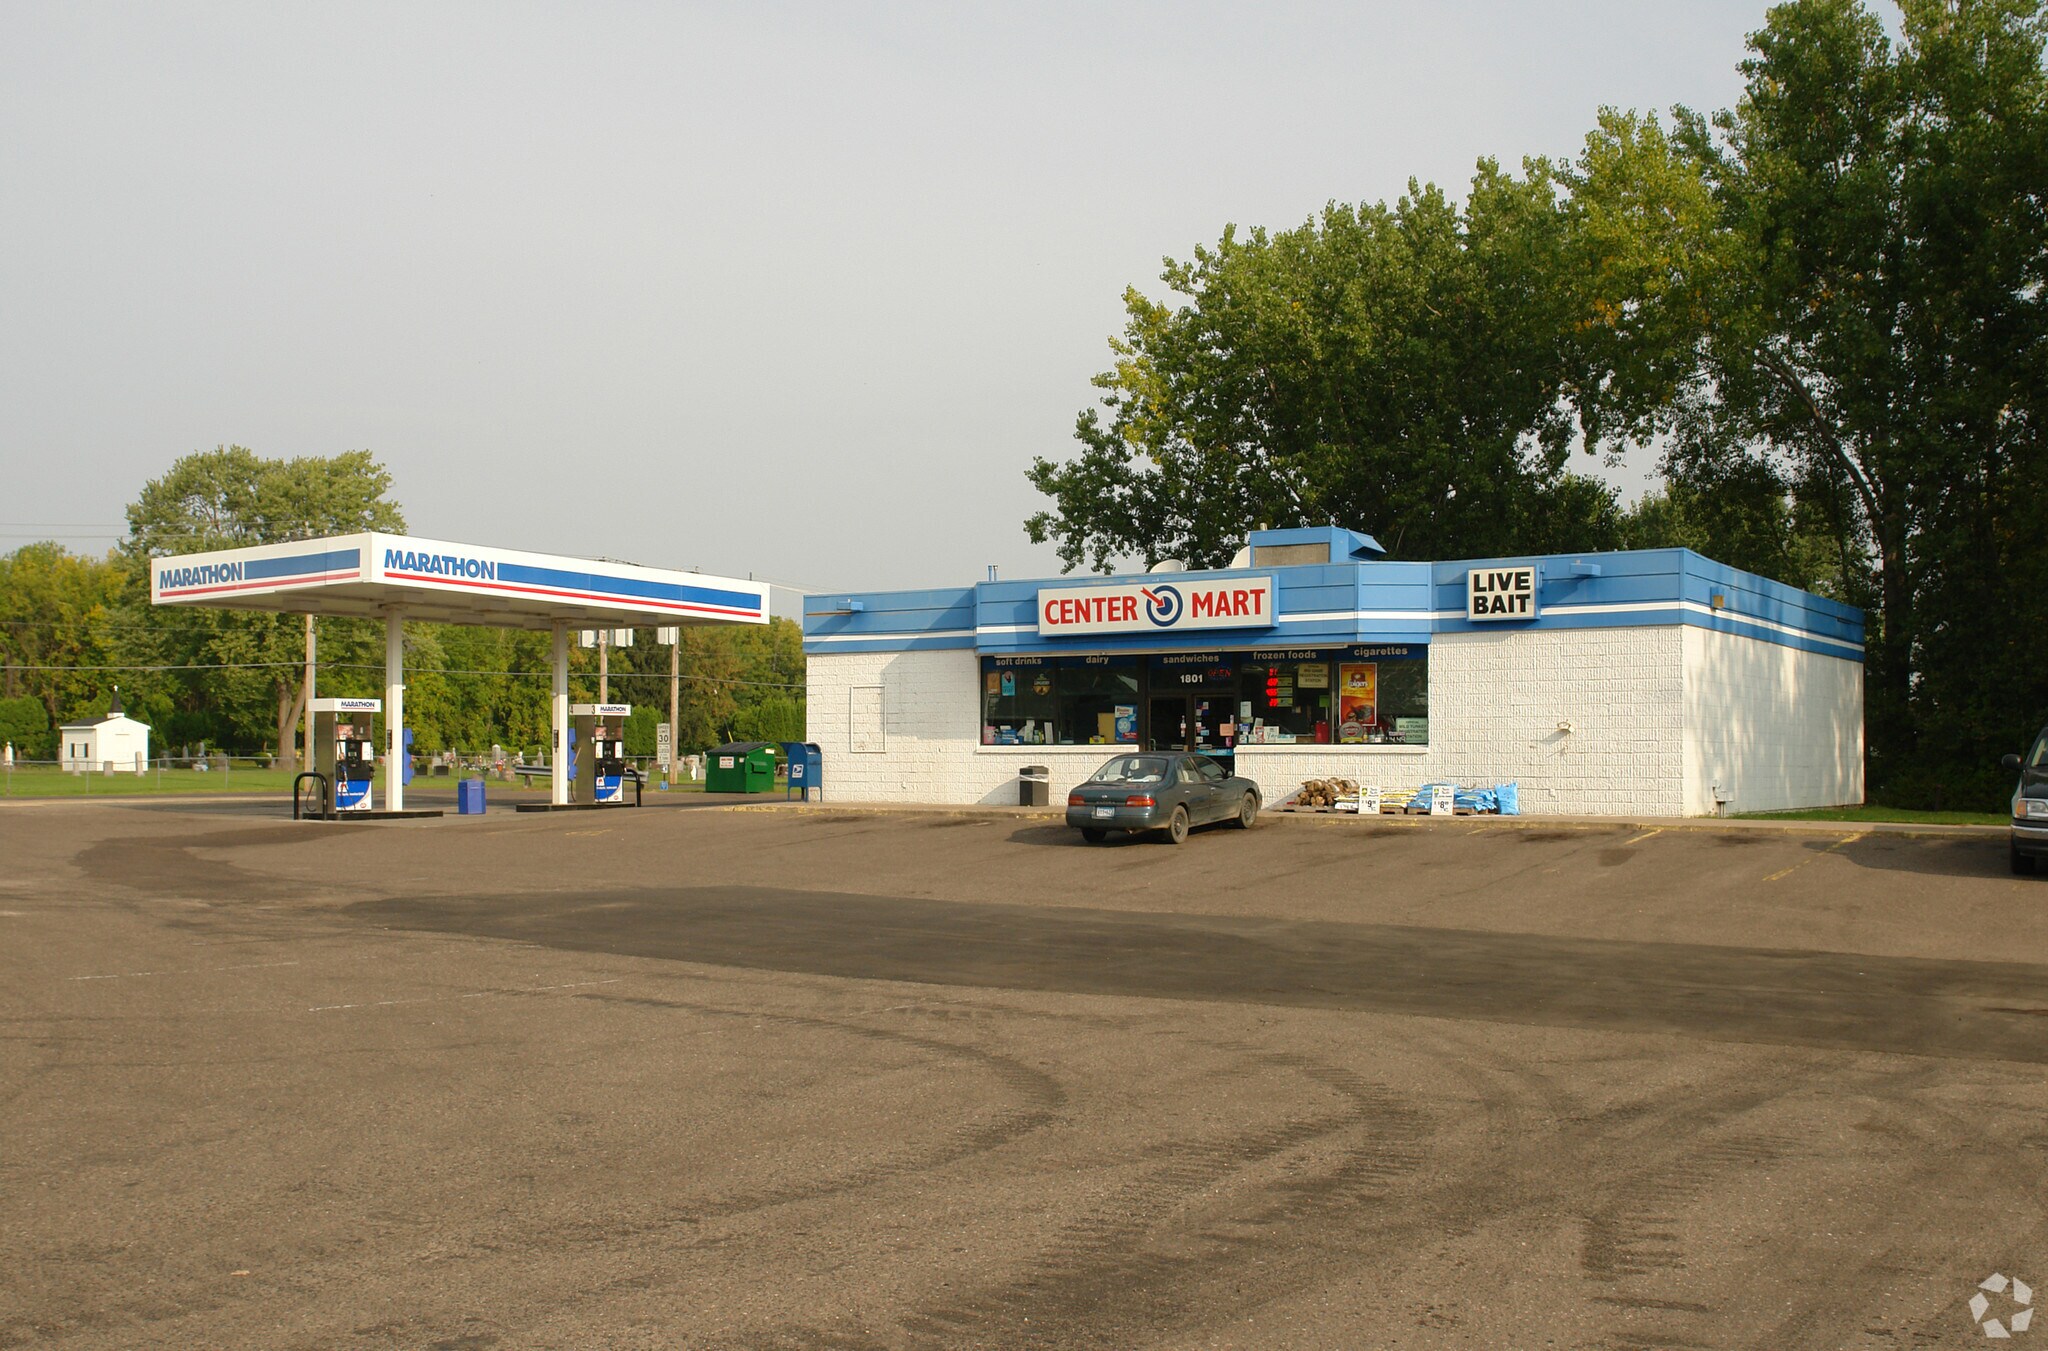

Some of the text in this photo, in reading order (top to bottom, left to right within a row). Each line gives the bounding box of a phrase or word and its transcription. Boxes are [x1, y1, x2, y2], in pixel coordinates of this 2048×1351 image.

[384, 549, 495, 580] MARATHON
[160, 562, 242, 589] MARATHON
[1473, 571, 1531, 592] LIVE
[1044, 588, 1266, 625] CENTER MART
[1473, 594, 1531, 614] BAIT
[1253, 650, 1317, 660] frozen foods
[1354, 647, 1408, 657] cigarettes
[996, 657, 1042, 666] soft drinks
[1086, 655, 1109, 665] dairy
[1163, 654, 1220, 664] sandwiches
[1180, 674, 1203, 683] 1801
